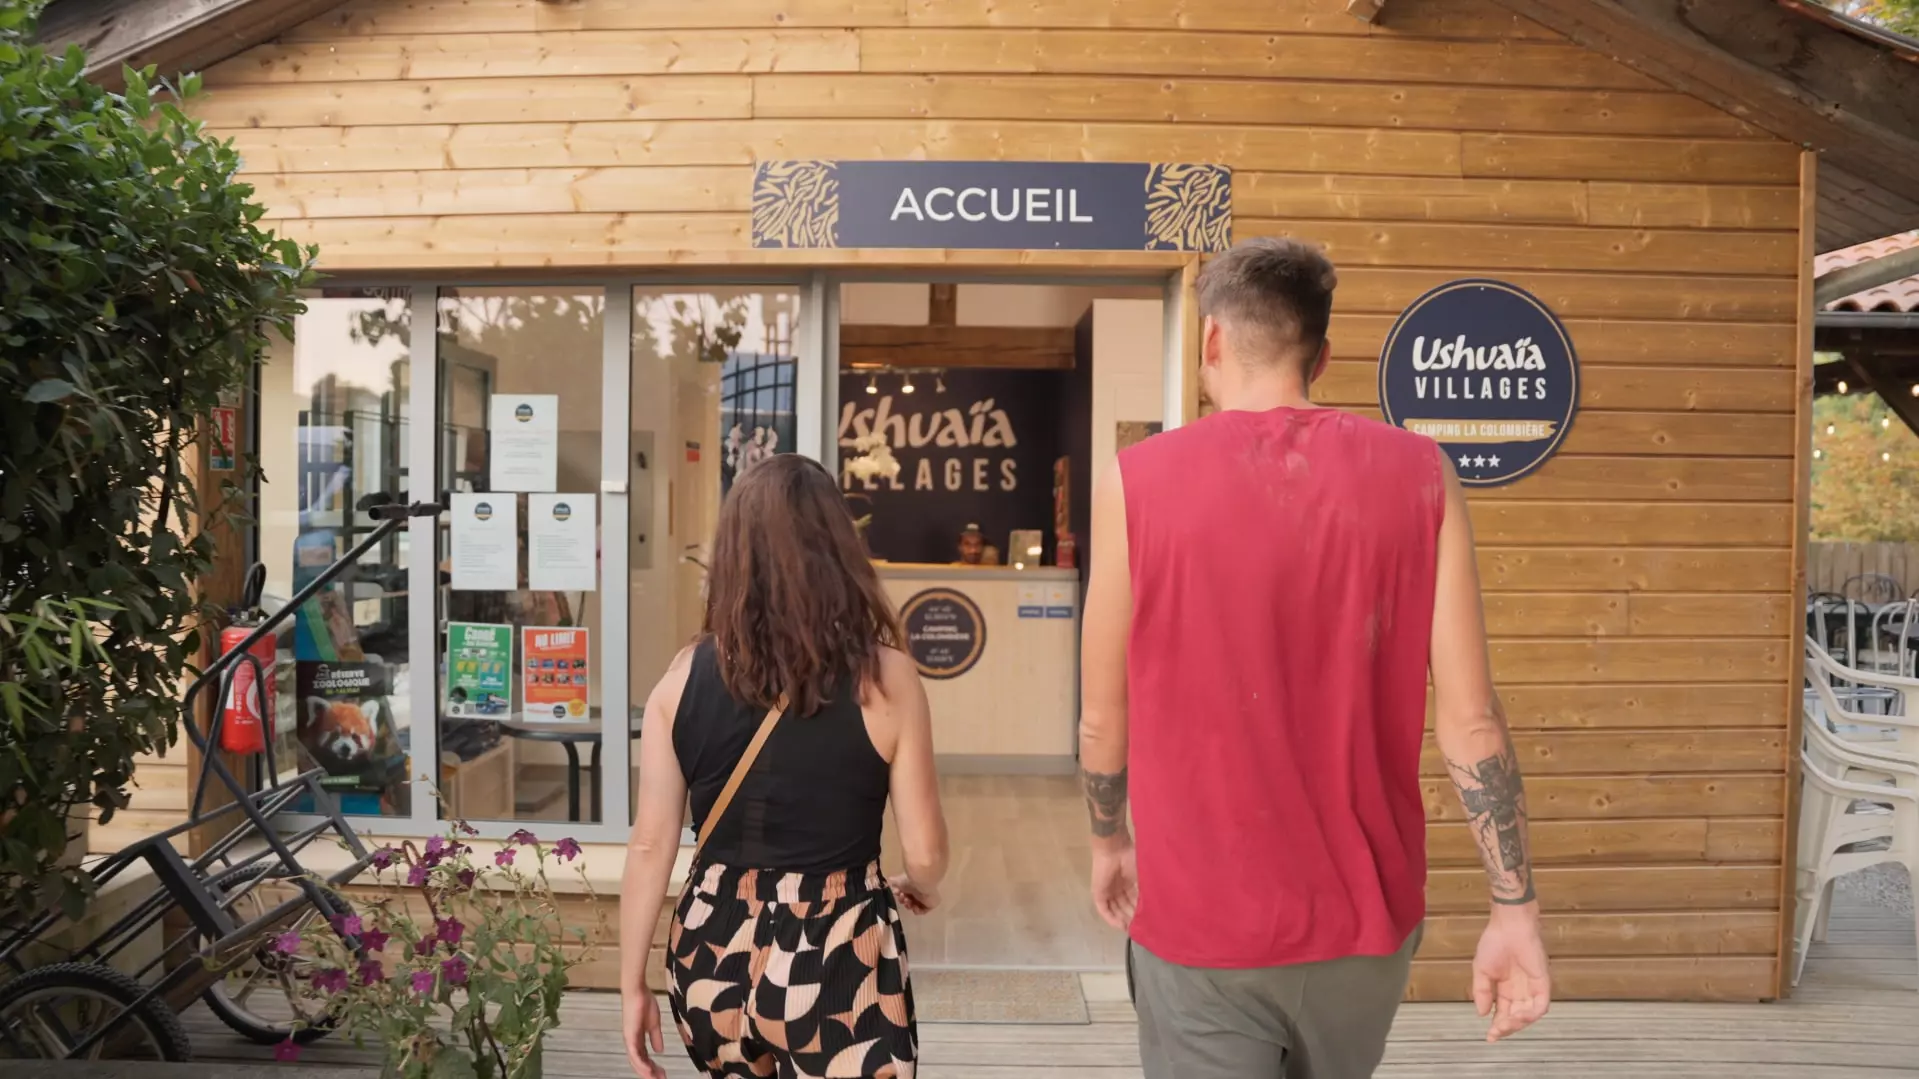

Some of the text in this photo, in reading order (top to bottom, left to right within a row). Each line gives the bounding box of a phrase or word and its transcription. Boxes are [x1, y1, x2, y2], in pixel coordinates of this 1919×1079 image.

[890, 187, 1093, 223] ACCUEIL
[1411, 334, 1546, 372] Ushuaïa
[1414, 376, 1547, 400] VILLAGES
[1413, 421, 1545, 437] CAMPING LA COLOMBIÈRE
